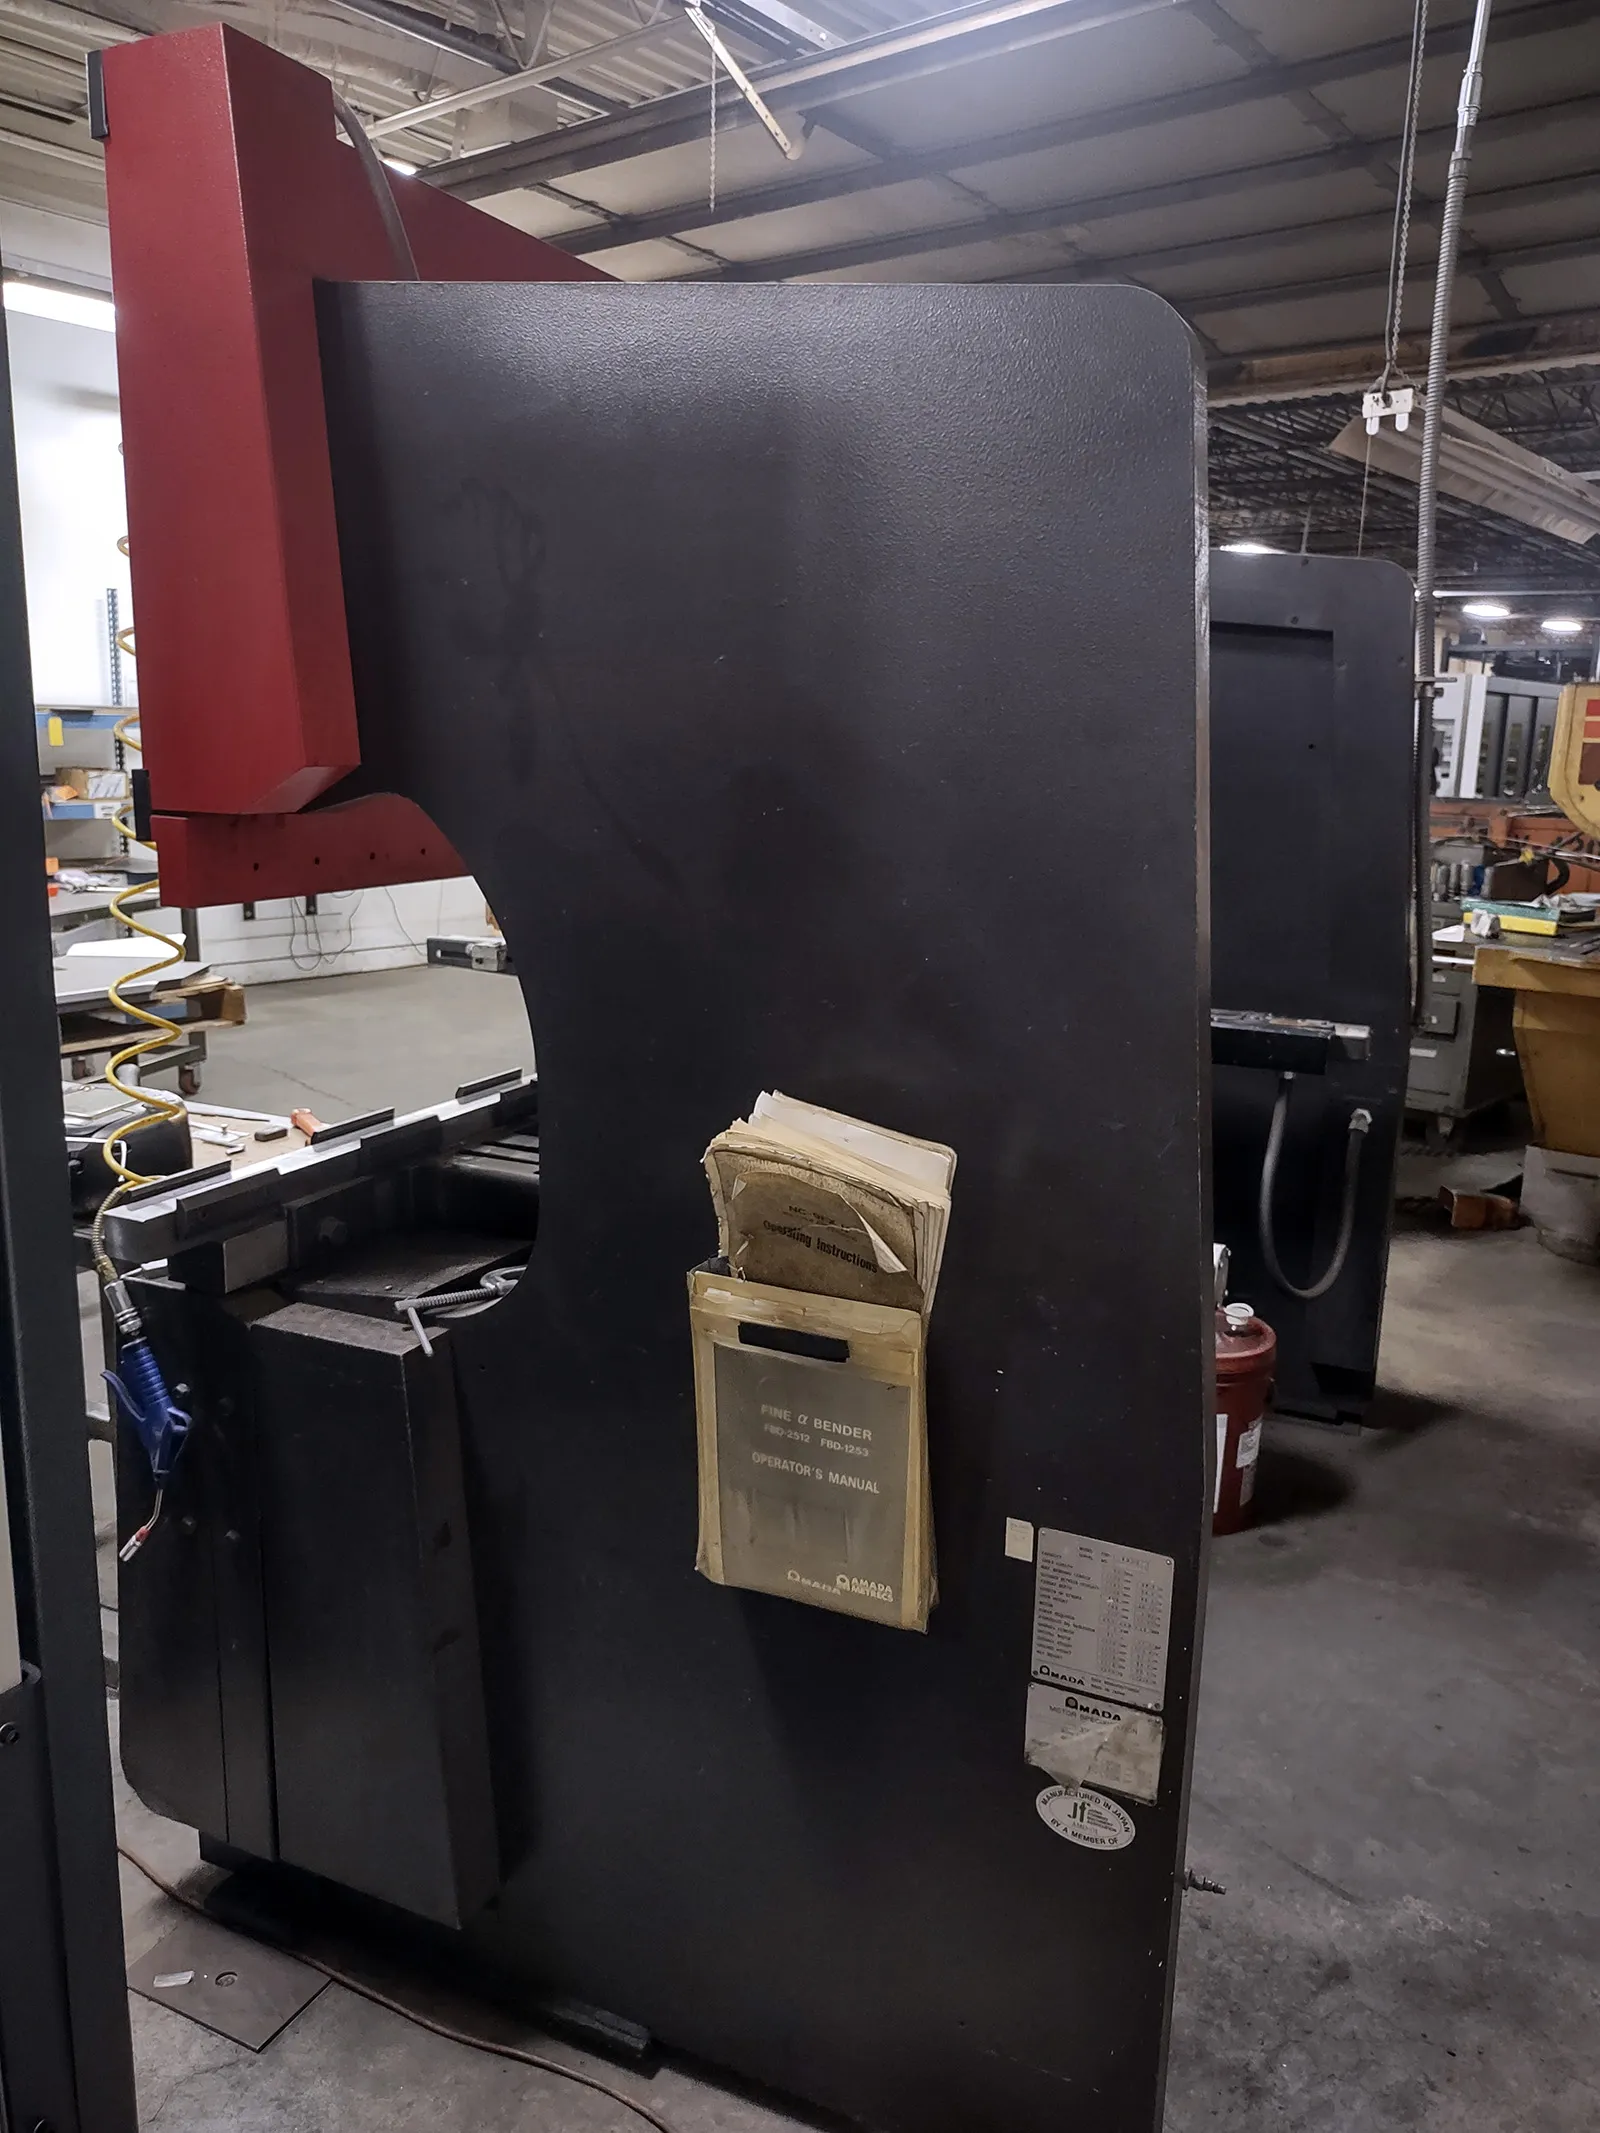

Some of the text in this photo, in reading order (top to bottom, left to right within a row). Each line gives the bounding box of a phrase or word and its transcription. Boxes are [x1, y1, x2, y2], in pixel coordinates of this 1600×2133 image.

[763, 1220, 812, 1248] Operating
[816, 1237, 878, 1274] Instructions
[761, 1404, 792, 1423] FINE
[813, 1418, 873, 1442] BENDER
[820, 1437, 869, 1457] FBD-1253
[751, 1451, 880, 1495] OPERATOR'S MANUAL
[1039, 1665, 1085, 1686] AMADA
[1065, 1696, 1122, 1721] AMADA
[1050, 1818, 1119, 1845] BY A MEMBER OF
[1102, 1801, 1112, 1811] IN
[1111, 1807, 1131, 1833] JAPAN
